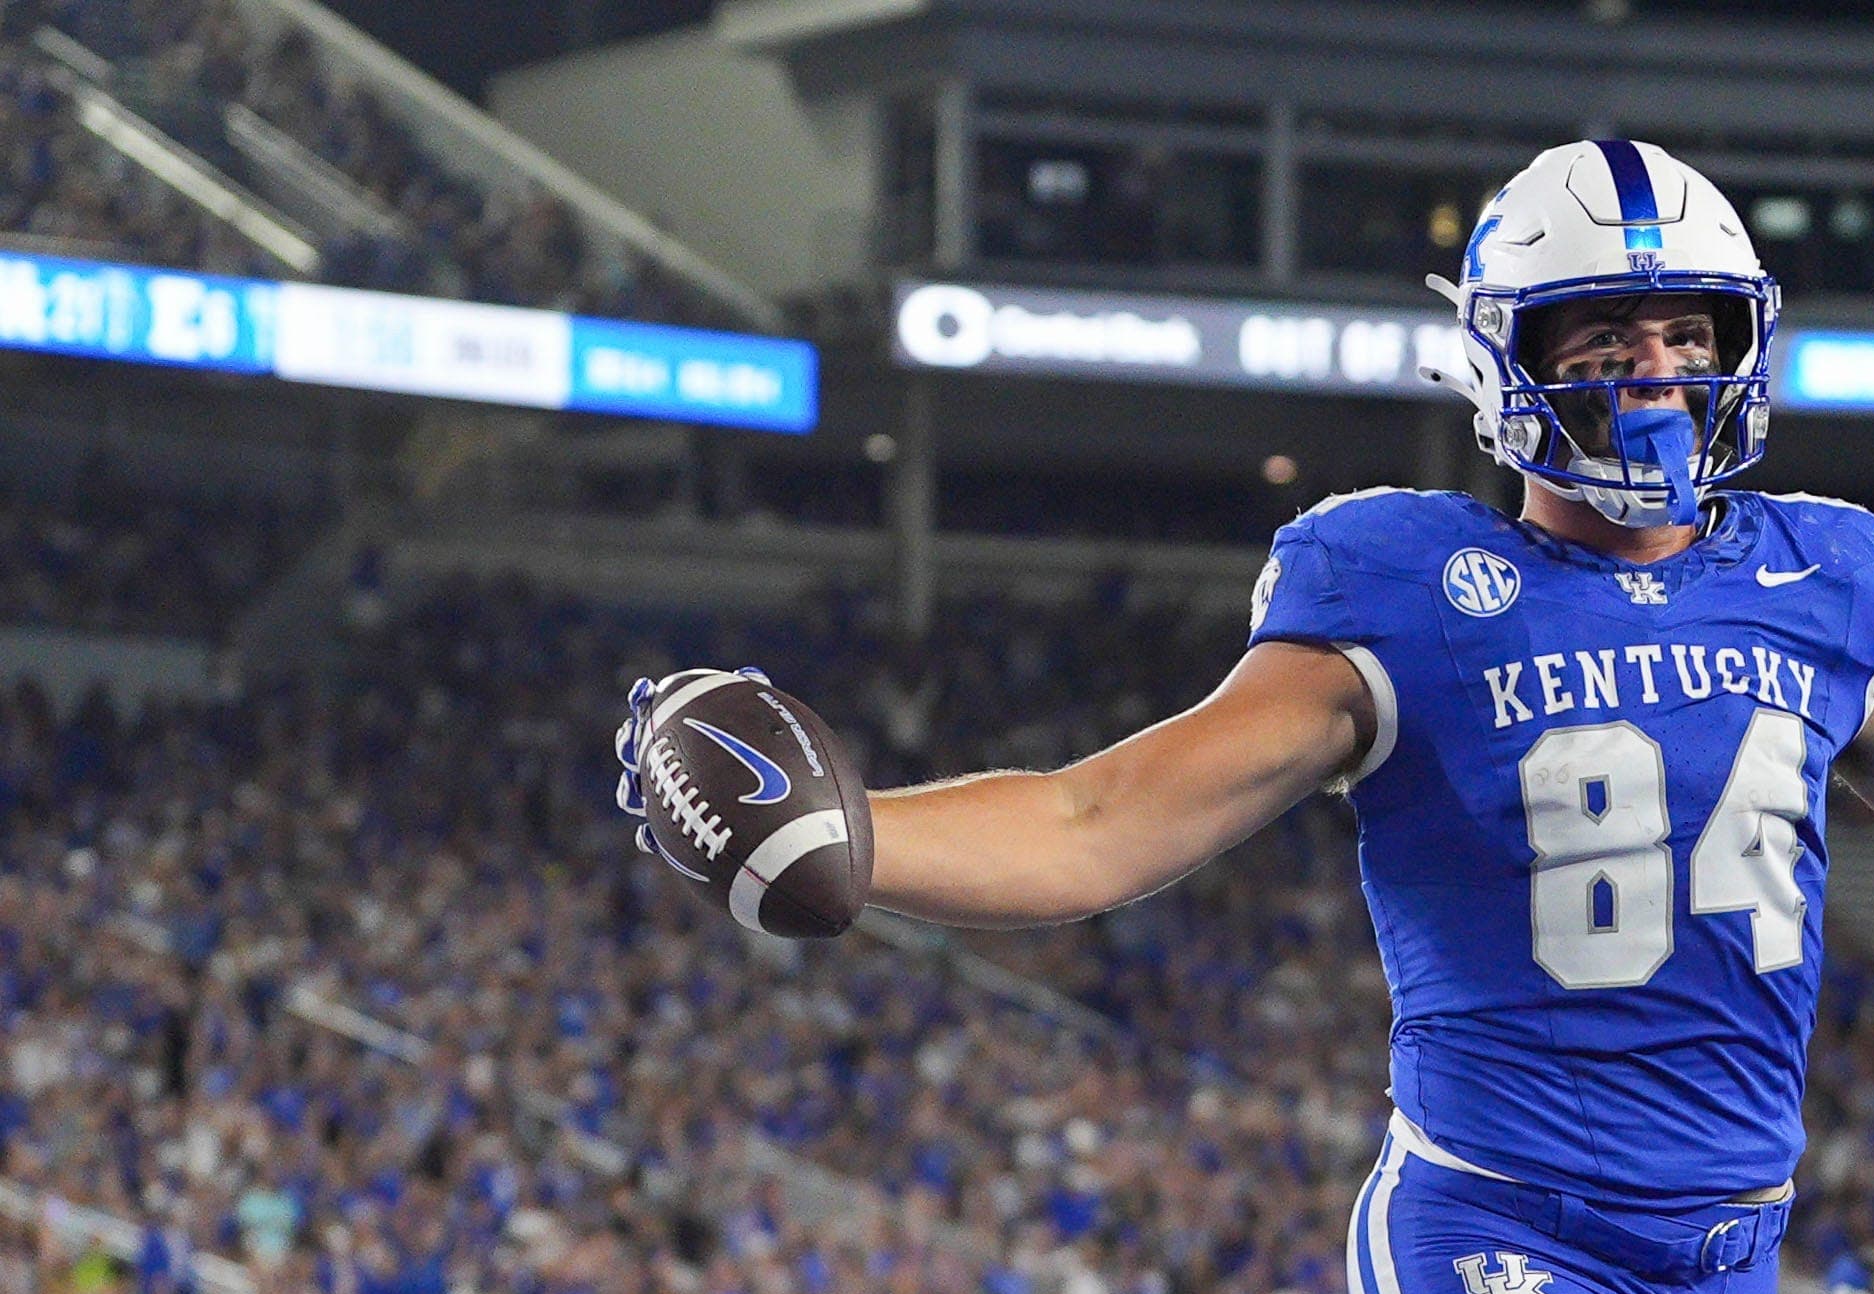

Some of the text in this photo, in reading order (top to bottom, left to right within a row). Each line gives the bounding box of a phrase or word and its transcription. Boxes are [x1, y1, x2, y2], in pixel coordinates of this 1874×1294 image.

[1448, 551, 1516, 612] SEC
[1614, 571, 1668, 605] UK
[1483, 644, 1815, 729] KENTUCKY
[1518, 706, 1809, 991] 84
